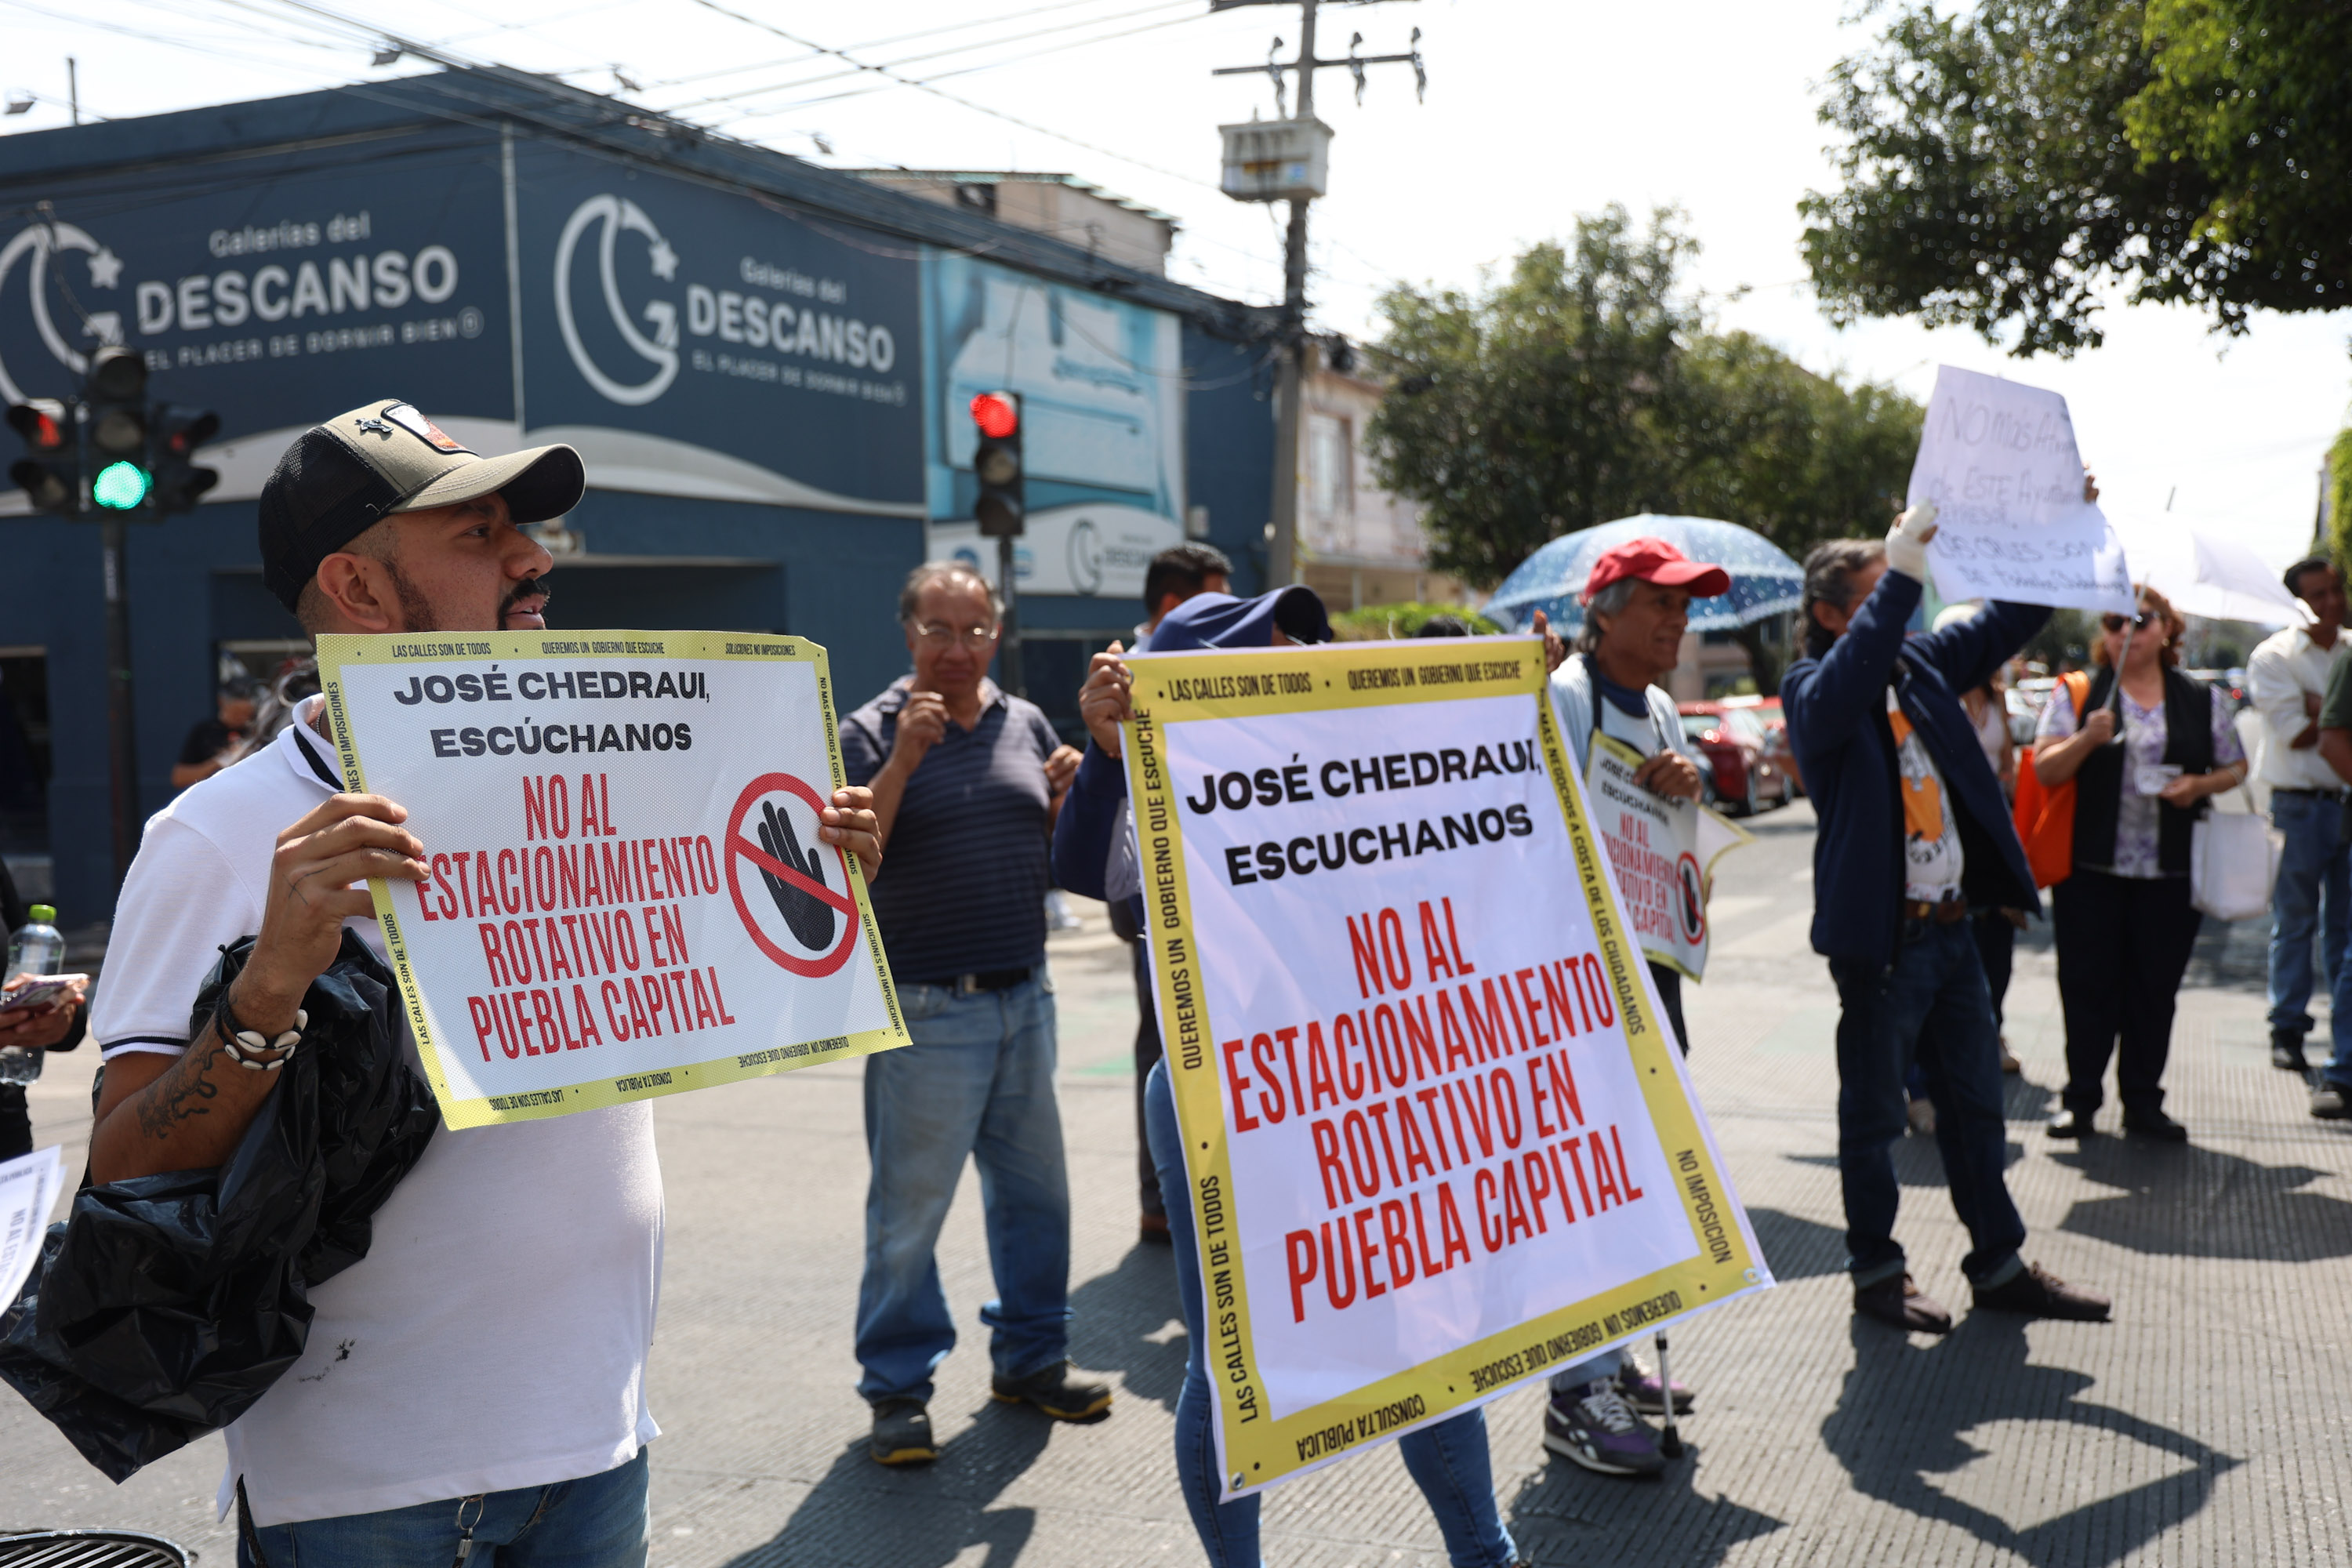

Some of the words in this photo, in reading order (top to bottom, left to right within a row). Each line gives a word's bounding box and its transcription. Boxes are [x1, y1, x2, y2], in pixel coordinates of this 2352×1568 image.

[327, 209, 372, 244] del
[136, 244, 459, 336] DESCANSO
[817, 277, 847, 305] del
[686, 283, 895, 373] DESCANSO
[144, 349, 172, 372] EL
[177, 338, 263, 368] PLACER
[269, 334, 300, 358] DE
[306, 324, 394, 354] DORMIR
[691, 349, 715, 372] EL
[392, 645, 408, 657] LAS
[408, 644, 437, 657] CALLES
[438, 643, 455, 655] SON
[456, 643, 466, 655] DE
[466, 642, 492, 655] TODOS
[542, 641, 579, 654] QUEREMOS
[579, 641, 590, 653] UN
[592, 641, 624, 653] GOBIERNO
[625, 641, 637, 653] QUE
[638, 642, 665, 654] ESCUCHE
[753, 644, 760, 655] NO
[394, 664, 513, 705] JOSÉ
[517, 671, 710, 703] CHEDRAUI,
[1168, 680, 1192, 701] LAS
[1192, 676, 1236, 699] CALLES
[1236, 674, 1260, 696] SON
[1261, 673, 1276, 695] DE
[1277, 672, 1312, 694] TODOS
[1348, 668, 1401, 691] QUEREMOS
[1401, 666, 1416, 687] UN
[1417, 664, 1464, 685] GOBIERNO
[1465, 662, 1483, 682] QUE
[1483, 660, 1521, 680] ESCUCHE
[328, 682, 352, 751] IMPOSICIONES
[820, 677, 827, 689] NO
[824, 711, 836, 753] NEGOCIOS
[832, 762, 842, 789] COSTA
[430, 717, 691, 757] ESCÚCHANOS
[1136, 708, 1161, 790] ESCUCHE
[343, 753, 356, 768] NO
[1187, 753, 1314, 815] JOSÉ
[1320, 739, 1542, 798] CHEDRAUI,
[1547, 747, 1577, 818] NEGOCIOS
[523, 774, 570, 841] NO
[582, 772, 617, 837] AL
[1148, 796, 1167, 832] QUE
[1225, 803, 1534, 886] ESCUCHANOS
[1571, 823, 1581, 833] A
[1619, 811, 1635, 841] NO
[413, 834, 719, 922] ESTACIONAMIENTO
[1573, 835, 1597, 884] COSTA
[1152, 836, 1181, 929] GOBIERNO
[1588, 886, 1604, 906] DE
[383, 913, 401, 946] TODOS
[862, 913, 882, 964] SOLUCIONES
[1595, 908, 1613, 938] LOS
[394, 948, 405, 961] DE
[478, 908, 640, 988] ROTATIVO
[643, 904, 689, 968] EN
[1167, 938, 1187, 964] UN
[1346, 907, 1412, 999] NO
[1418, 896, 1475, 982] AL
[398, 964, 412, 984] SON
[877, 965, 887, 977] NO
[1604, 939, 1646, 1036] CIUDADANOS
[405, 985, 424, 1024] CALLES
[467, 980, 603, 1062] PUEBLA
[602, 966, 735, 1042] CAPITAL
[881, 978, 904, 1036] IMPOSICIONES
[1171, 968, 1203, 1071] QUEREMOS
[419, 1025, 430, 1045] LAS
[781, 1044, 810, 1060] GOBIERNO
[811, 1041, 820, 1054] UN
[819, 1036, 849, 1052] QUEREMOS
[1221, 952, 1614, 1134] ESTACIONAMIENTO
[738, 1052, 768, 1068] ESCUCHE
[767, 1049, 780, 1062] QUE
[530, 1091, 552, 1106] CALLES
[551, 1089, 564, 1102] LAS
[615, 1076, 643, 1092] PÚBLICA
[643, 1072, 672, 1088] CONSULTA
[488, 1097, 510, 1110] TODOS
[508, 1096, 518, 1109] DE
[517, 1094, 531, 1108] SON
[1310, 1066, 1523, 1210] ROTATIVO
[1526, 1048, 1586, 1139] EN
[1676, 1149, 1699, 1173] NO
[1200, 1176, 1225, 1238] TODOS
[1284, 1181, 1471, 1323] PUEBLA
[1474, 1124, 1642, 1253] CAPITAL
[1685, 1174, 1733, 1265] IMPOSICION
[1209, 1240, 1230, 1267] DE
[1214, 1269, 1234, 1310] SON
[1603, 1313, 1623, 1338] UN
[1620, 1290, 1683, 1330] QUEREMOS
[1220, 1312, 1248, 1385] CALLES
[1523, 1342, 1548, 1371] QUE
[1546, 1321, 1603, 1361] GOBIERNO
[1469, 1353, 1524, 1393] ESCUCHE
[1236, 1385, 1258, 1424] LAS
[1356, 1393, 1426, 1439] CONSULTA
[1296, 1420, 1355, 1461] PÚBLICA
